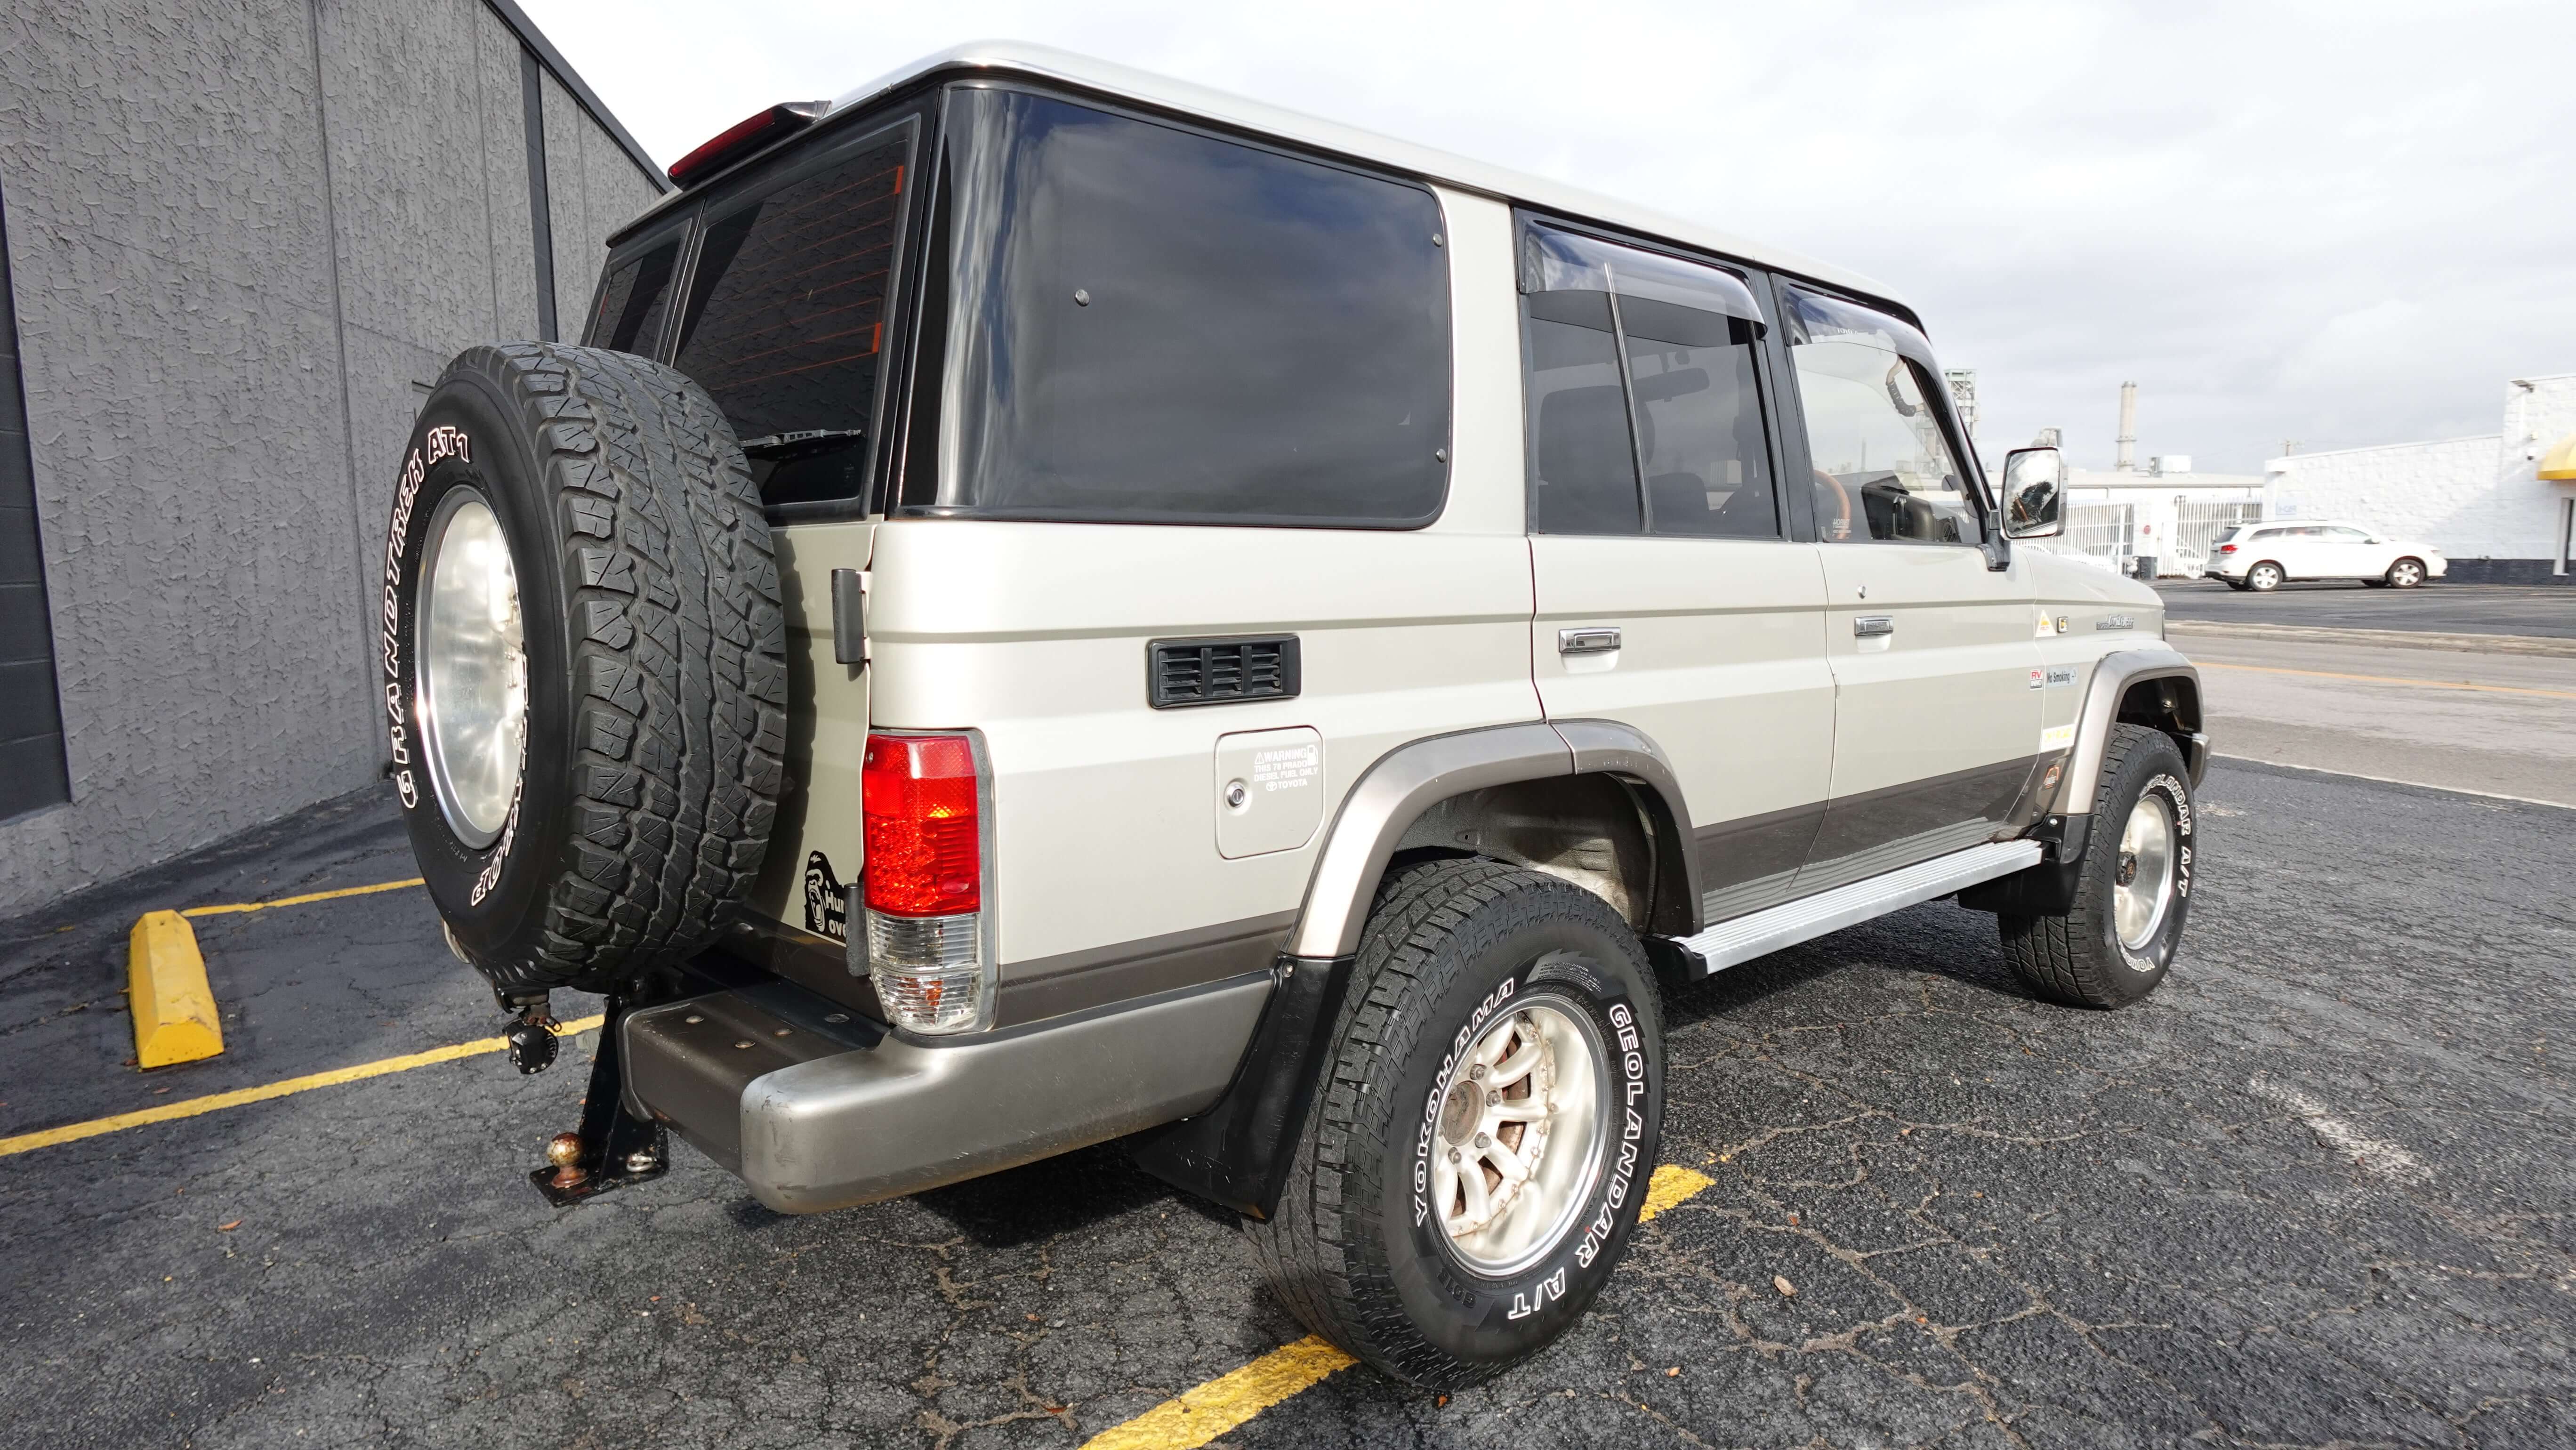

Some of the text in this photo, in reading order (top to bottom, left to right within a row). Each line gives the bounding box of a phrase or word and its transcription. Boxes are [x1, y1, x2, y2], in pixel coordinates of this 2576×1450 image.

[384, 426, 469, 808] GRANDTREK AT1
[2031, 670, 2042, 679] RV
[2047, 671, 2070, 684] No Smoking
[1264, 749, 1307, 762] WARNING
[1254, 764, 1271, 773] THIS
[1283, 760, 1307, 769] PRADO
[1254, 767, 1319, 782] DIESEL FUEL ONLY
[1278, 778, 1308, 789] TOYOTA
[2178, 846, 2191, 897] A/T
[1415, 977, 1515, 1227] YOKOHAMA
[1578, 1003, 1644, 1269] GEOLANDAR
[1508, 1267, 1567, 1321] A/T
